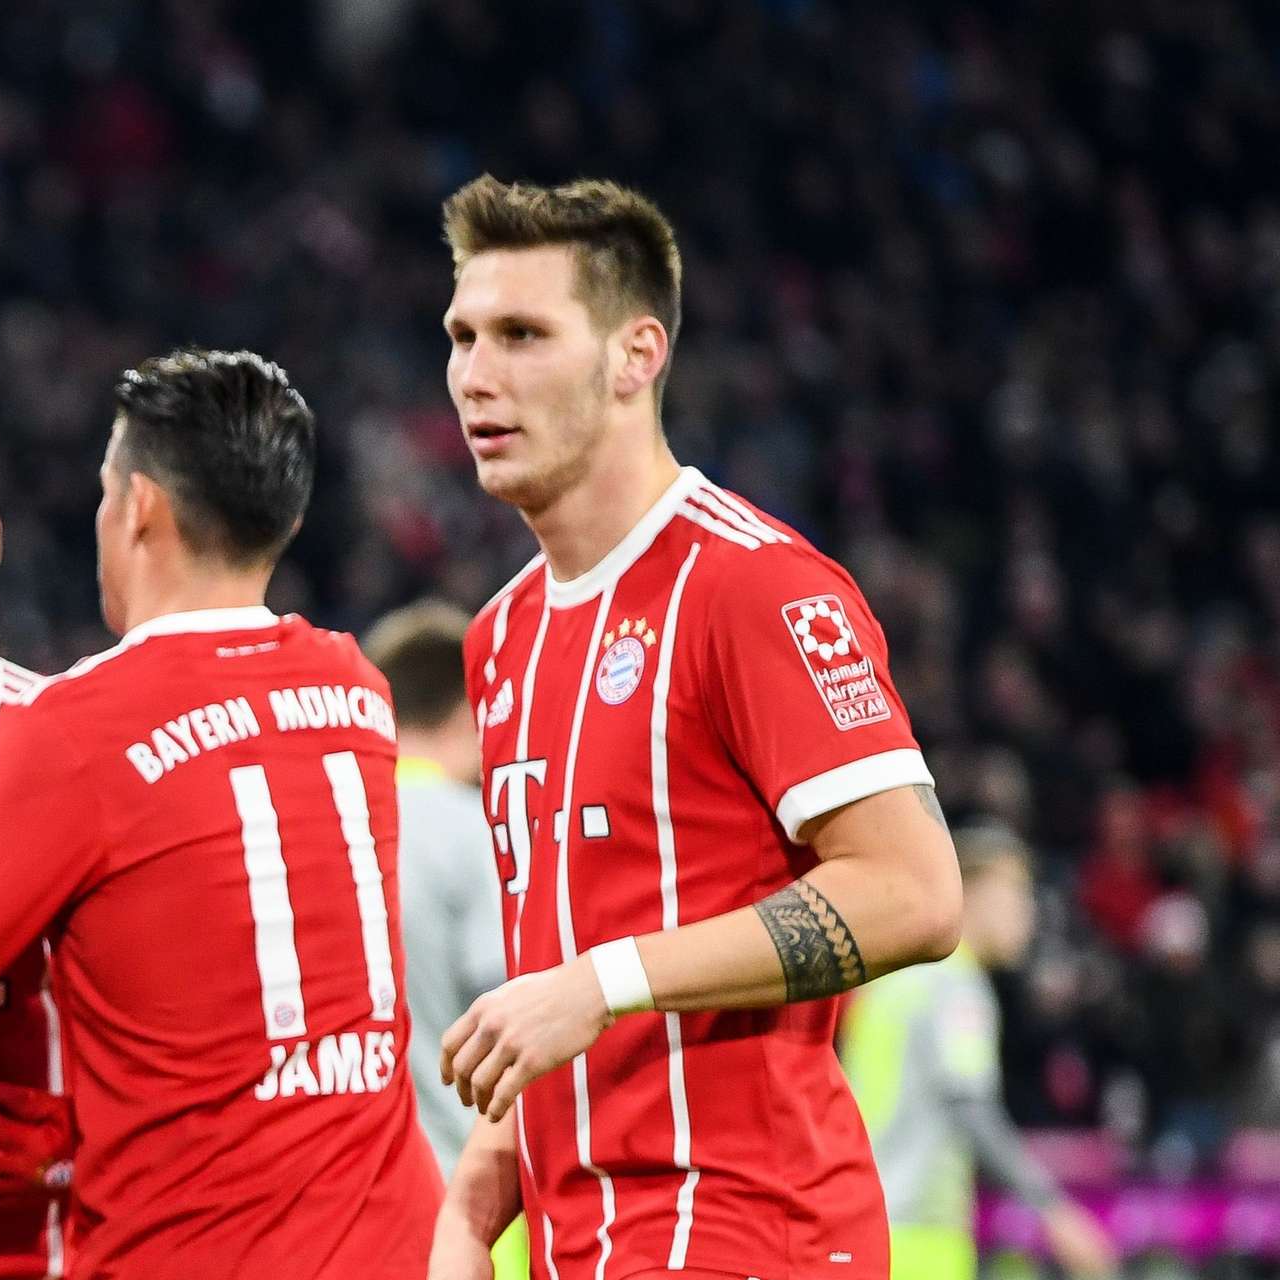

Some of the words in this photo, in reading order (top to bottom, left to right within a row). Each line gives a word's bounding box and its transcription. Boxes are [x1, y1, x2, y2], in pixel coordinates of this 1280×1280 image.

[815, 656, 870, 688] Hamad
[826, 675, 876, 704] Airport
[125, 696, 262, 785] BAYERN
[228, 749, 399, 1041] 11
[254, 1030, 397, 1102] JAMES
